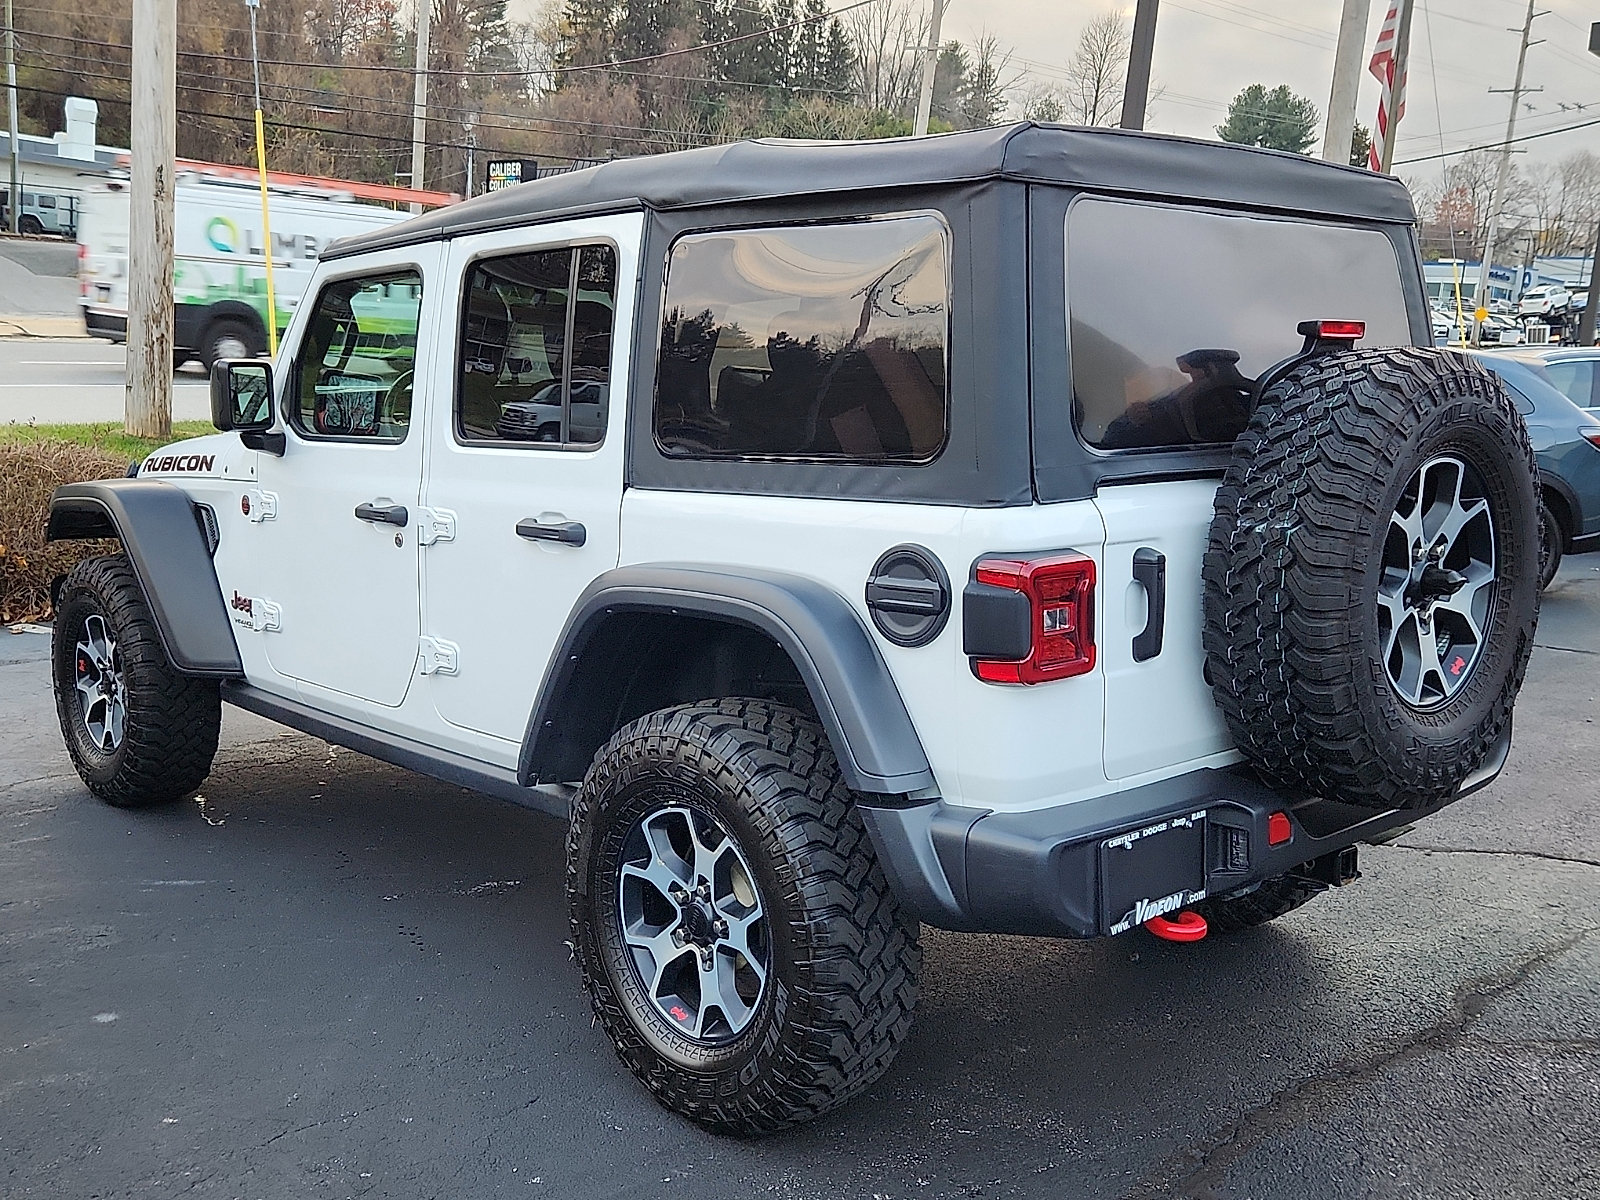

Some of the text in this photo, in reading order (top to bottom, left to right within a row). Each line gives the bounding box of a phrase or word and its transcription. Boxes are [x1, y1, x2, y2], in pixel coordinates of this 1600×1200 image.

[489, 162, 522, 177] CALIBER
[245, 229, 320, 260] LIMB
[142, 455, 216, 472] RUBICON
[1142, 822, 1168, 837] DODGE
[1171, 817, 1187, 828] Jeep
[1191, 810, 1207, 821] RAM
[1109, 889, 1206, 936] www. VIDEON .com
